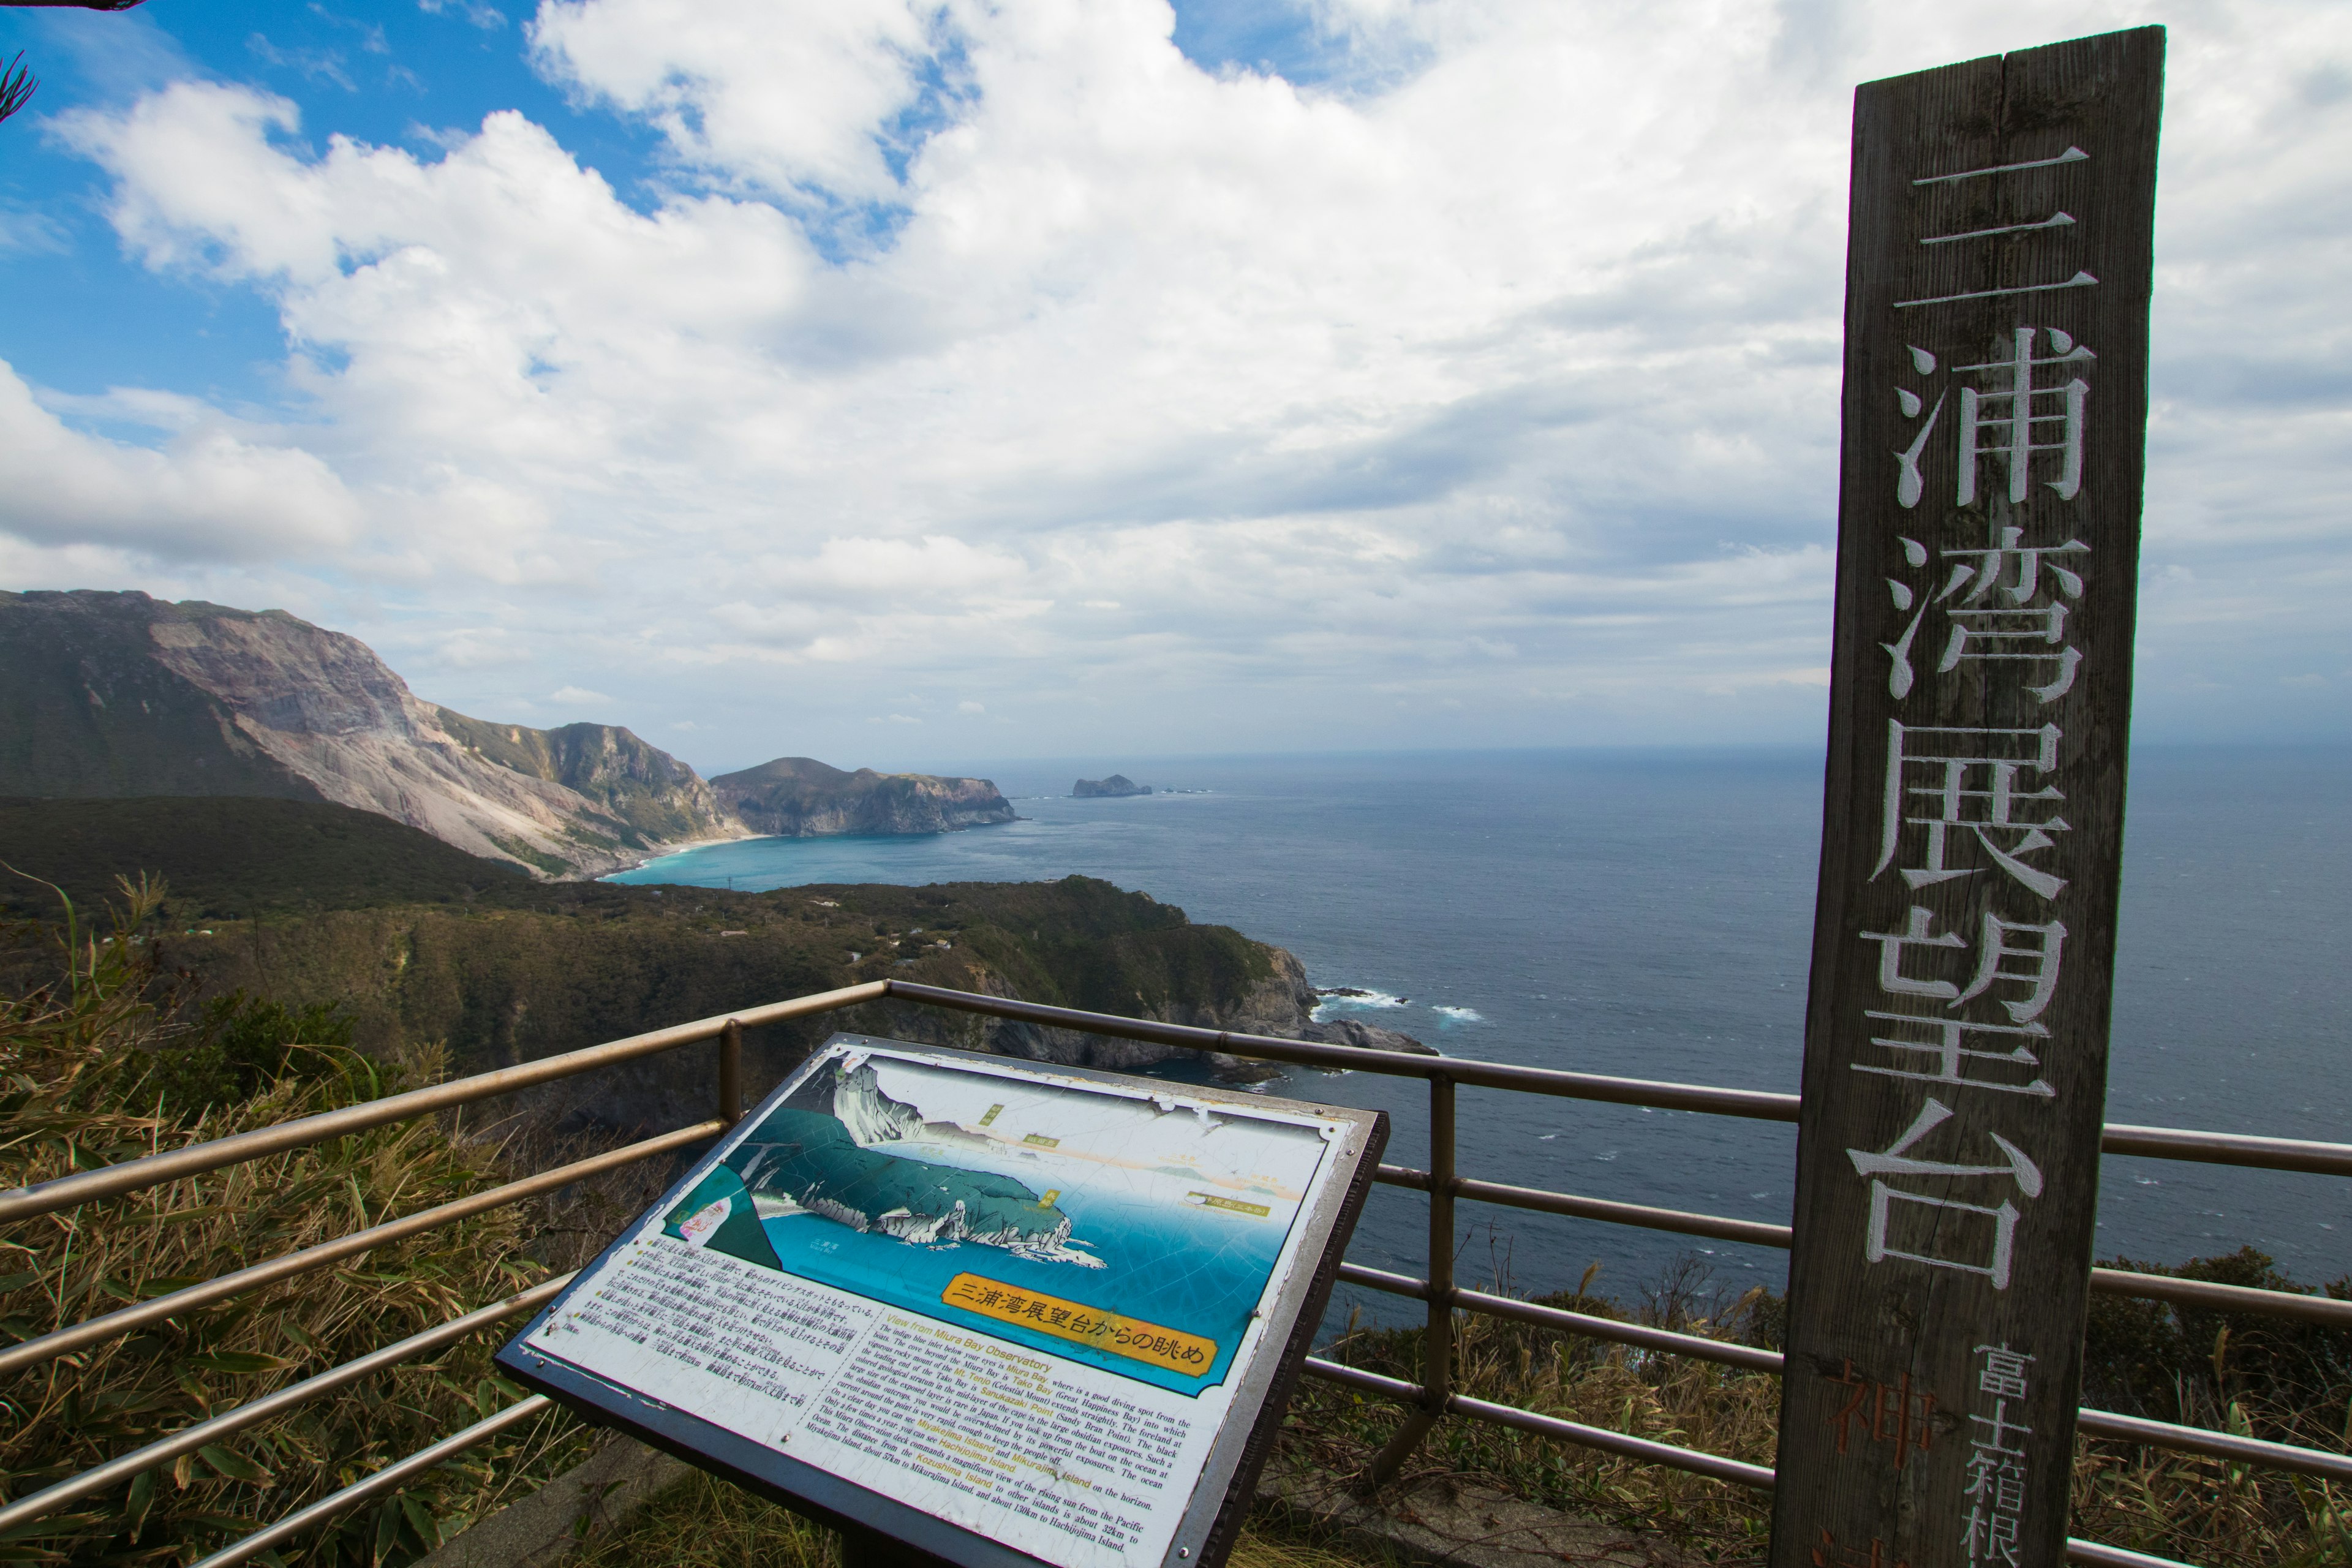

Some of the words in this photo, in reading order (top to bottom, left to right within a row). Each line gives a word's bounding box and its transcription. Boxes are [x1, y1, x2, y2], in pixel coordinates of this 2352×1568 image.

[1845, 145, 2099, 1291] 三浦湾展望台
[880, 1324, 892, 1333] The
[892, 1328, 912, 1340] indigo
[913, 1335, 927, 1344] blue
[927, 1339, 943, 1350] inlet
[943, 1344, 963, 1355] below
[963, 1353, 981, 1362] your
[981, 1358, 997, 1367] eyes
[1006, 1364, 1030, 1378] Miura
[1052, 1380, 1074, 1392] where
[1091, 1393, 1110, 1403] good
[1111, 1398, 1136, 1412] diving
[1137, 1408, 1154, 1417] spot
[1156, 1412, 1175, 1424] from
[887, 1314, 909, 1327] View
[911, 1322, 933, 1335] from
[934, 1329, 963, 1344] Miura
[963, 1338, 985, 1352] Bay
[986, 1345, 1052, 1374] Observatory
[952, 1283, 1205, 1365] 三浦湾展望台からの眺め
[824, 1395, 840, 1408] Only
[858, 1409, 876, 1421] times
[938, 1438, 988, 1463] Hachijojima
[837, 1381, 861, 1393] current
[860, 1389, 884, 1401] around
[894, 1401, 913, 1412] point
[921, 1411, 937, 1421] very
[957, 1425, 982, 1438] enough
[992, 1434, 1010, 1448] keep
[1022, 1448, 1048, 1461] people
[849, 1362, 865, 1374] large
[900, 1382, 927, 1395] exposed
[926, 1389, 944, 1401] layer
[952, 1401, 968, 1410] rare
[977, 1408, 999, 1421] Japan.
[1025, 1423, 1041, 1435] look
[1054, 1433, 1072, 1446] from
[1089, 1446, 1106, 1458] boat
[1135, 1464, 1157, 1476] ocean
[855, 1357, 879, 1368] colored
[877, 1364, 910, 1379] geological
[909, 1375, 935, 1387] stratum
[956, 1391, 989, 1406] mid-layer
[1011, 1409, 1027, 1419] cape
[1049, 1421, 1069, 1434] large
[1071, 1429, 1102, 1445] obsidian
[1103, 1441, 1143, 1460] exposures.
[1145, 1453, 1165, 1467] Such
[856, 1376, 881, 1390] obsidian
[930, 1403, 951, 1415] would
[964, 1415, 1011, 1436] overwhelmed
[1038, 1442, 1074, 1458] powerful
[1076, 1455, 1115, 1474] exposures.
[1121, 1468, 1137, 1480] The
[1140, 1477, 1163, 1490] ocean
[868, 1340, 894, 1353] vigorous
[894, 1349, 912, 1360] rocky
[912, 1355, 933, 1366] mount
[969, 1372, 991, 1385] Tenjo
[992, 1381, 1025, 1396] (Celestial
[1024, 1391, 1050, 1406] Mount)
[1051, 1401, 1079, 1415] extends
[1080, 1411, 1118, 1428] straightly.
[1139, 1428, 1172, 1445] foreland
[873, 1331, 889, 1343] boats.
[894, 1338, 906, 1348] The
[924, 1348, 949, 1361] beyond
[963, 1360, 984, 1373] Miura
[1013, 1376, 1033, 1389] Tako
[1036, 1384, 1053, 1395] Bay
[1055, 1391, 1079, 1404] (Great
[1081, 1398, 1120, 1417] Happiness
[1122, 1411, 1140, 1425] Bay)
[1164, 1427, 1186, 1439] which
[873, 1351, 897, 1365] leading
[936, 1371, 952, 1383] Tako
[980, 1387, 1028, 1408] Sanukazaki
[1030, 1403, 1054, 1417] Point
[1056, 1412, 1082, 1427] (Sandy
[1084, 1421, 1103, 1434] Bran
[1106, 1428, 1131, 1444] Point).
[1156, 1445, 1177, 1458] black
[804, 1422, 841, 1441] Miyakejima
[862, 1446, 883, 1458] about
[882, 1452, 901, 1465] 57km
[910, 1463, 950, 1485] Mikurajima
[990, 1496, 1012, 1510] about
[1013, 1504, 1038, 1520] 130km
[1049, 1517, 1096, 1543] Hachijojima
[1097, 1535, 1125, 1553] Island.
[812, 1413, 831, 1427] Ocean.
[836, 1422, 849, 1433] The
[851, 1429, 878, 1444] distance
[880, 1439, 898, 1452] from
[916, 1453, 962, 1477] Kozushima
[965, 1472, 993, 1489] Island
[1007, 1490, 1029, 1502] other
[1031, 1498, 1060, 1515] islands
[1074, 1515, 1098, 1529] about
[1102, 1524, 1125, 1540] 32km
[819, 1404, 834, 1415] This
[833, 1410, 854, 1423] Miura
[854, 1418, 892, 1438] Observation
[892, 1433, 910, 1445] deck
[910, 1441, 945, 1458] commands
[951, 1457, 994, 1477] magnificent
[995, 1472, 1013, 1484] view
[1038, 1488, 1062, 1504] rising
[1077, 1502, 1098, 1517] from
[1115, 1515, 1144, 1533] Pacific
[847, 1394, 864, 1405] clear
[917, 1419, 963, 1441] Miyakejima
[964, 1436, 996, 1453] Islasnd
[1059, 1471, 1092, 1489] Island
[1120, 1492, 1152, 1511] horizon.
[1811, 1357, 1937, 1568] 神
[1959, 1341, 2038, 1568] 富士箱根
